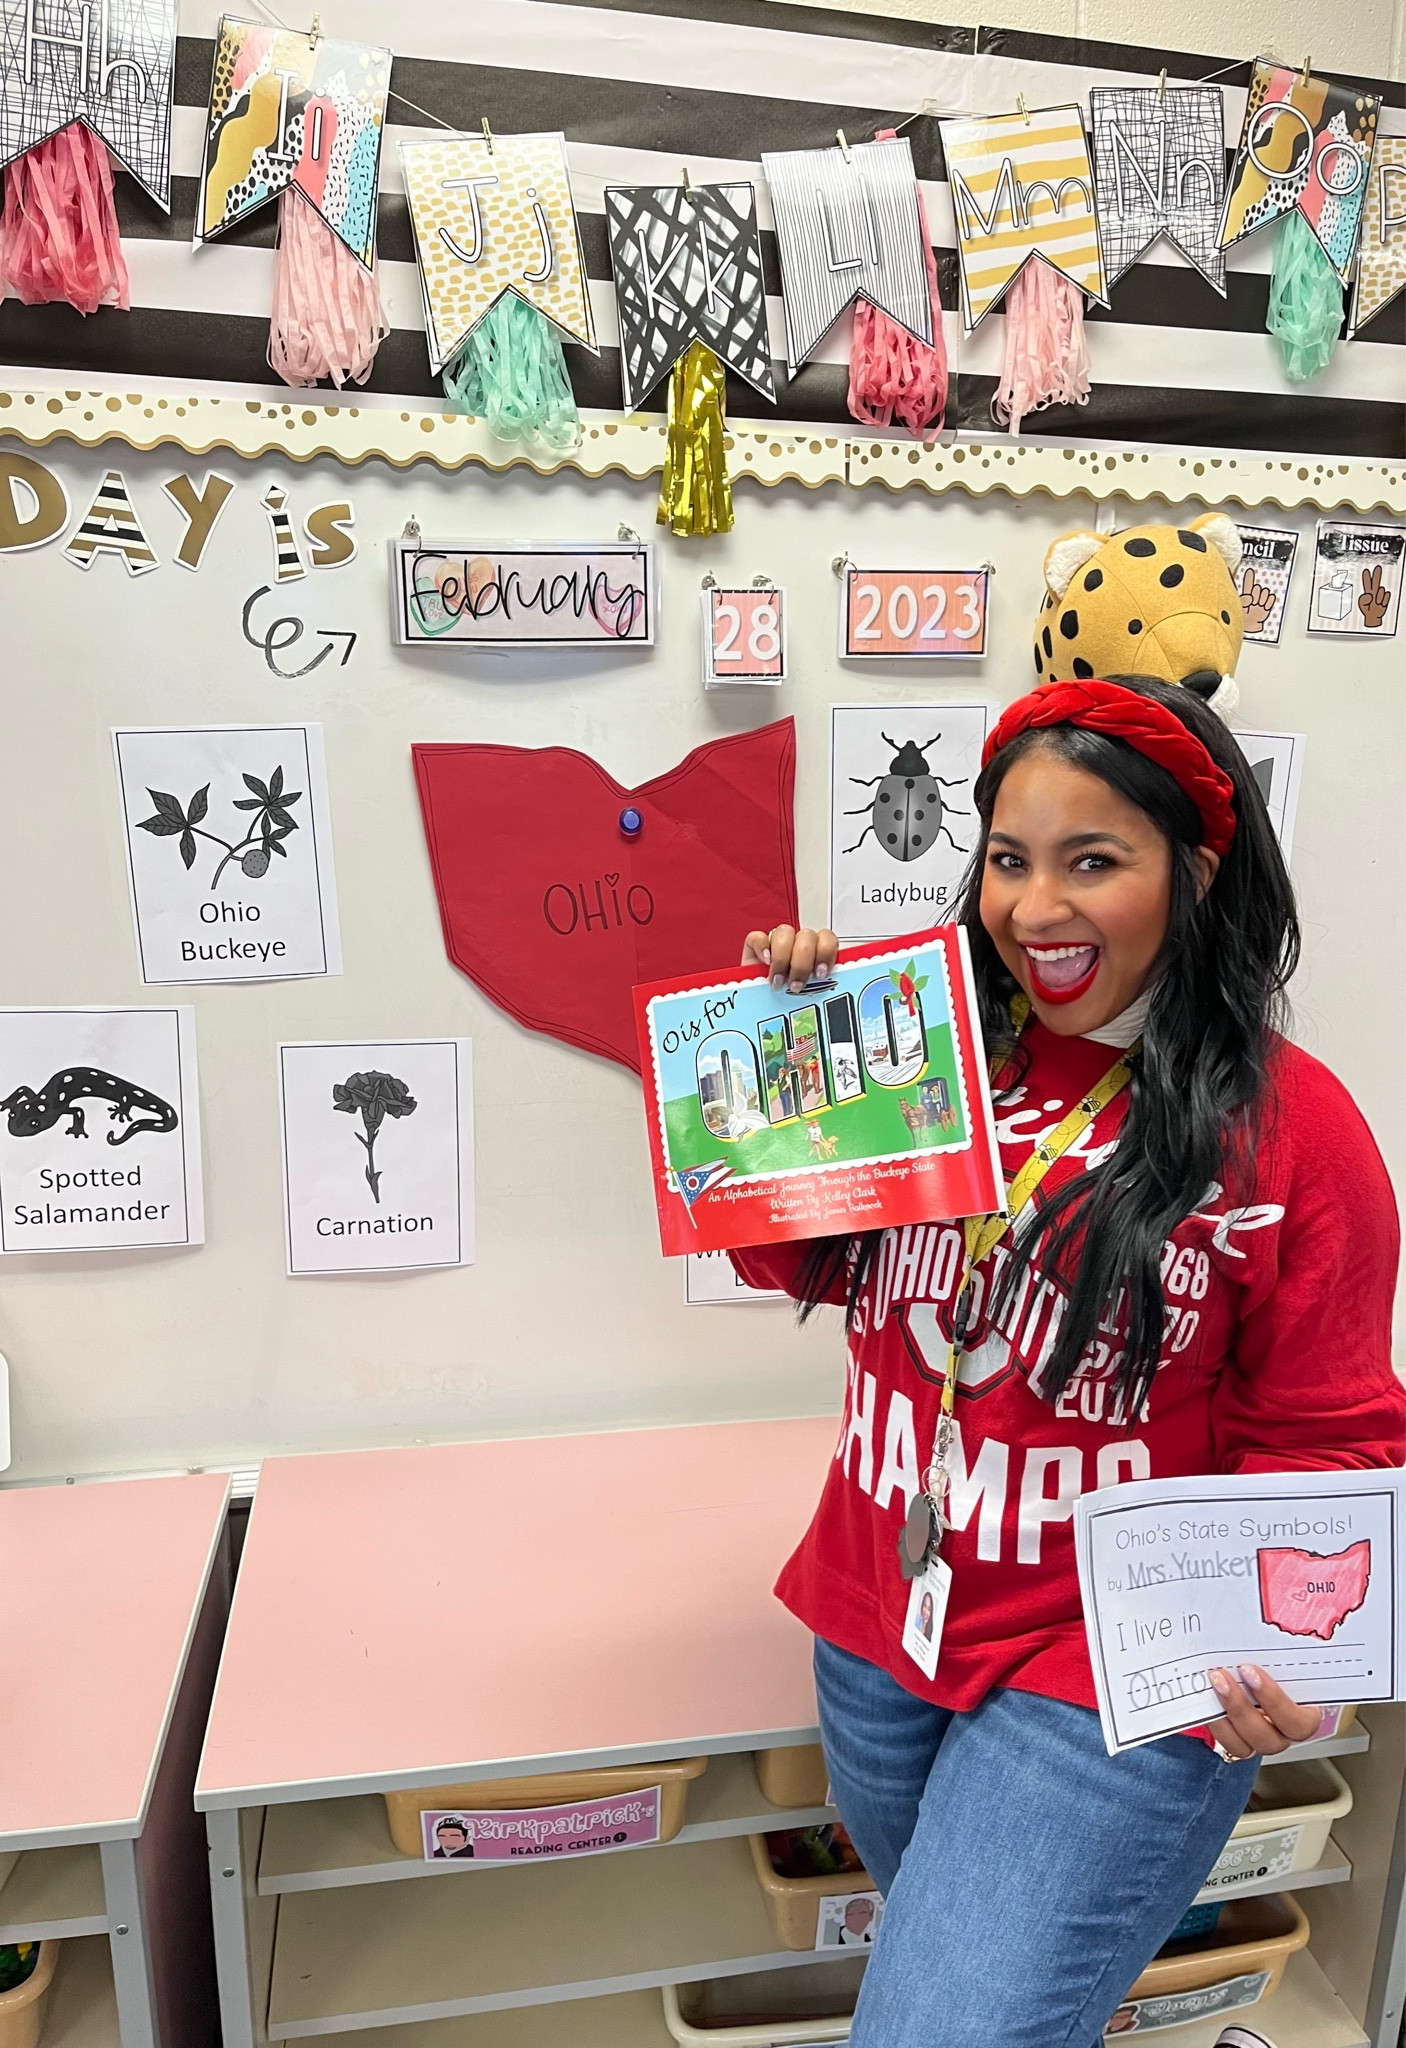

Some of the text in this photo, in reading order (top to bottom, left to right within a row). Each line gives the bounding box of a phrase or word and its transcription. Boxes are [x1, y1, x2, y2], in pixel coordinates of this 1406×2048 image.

[24, 0, 148, 104] Hh
[266, 67, 329, 164] Ii
[1108, 119, 1217, 221] Nn
[1247, 101, 1363, 196] Oo
[952, 157, 1093, 241] Mm
[438, 175, 555, 284] Jj
[815, 172, 879, 272] Ll
[262, 483, 358, 582] is
[1243, 540, 1276, 558] ncil
[1340, 533, 1390, 553] Tissue
[410, 553, 645, 637] February
[422, 595, 445, 611] TRU
[853, 584, 981, 641] 2023
[714, 603, 780, 661] 28
[199, 900, 261, 924] Ohio
[860, 881, 948, 908] Ladybug
[181, 936, 287, 963] Buckeye
[662, 989, 738, 1054] O is for
[695, 974, 929, 1143] OHIO
[39, 1164, 143, 1193] Spotted
[708, 1161, 936, 1205] An Alphabetical Journey Through the Buckeye State
[770, 1196, 803, 1210] Written
[852, 1185, 878, 1199] Clark
[14, 1200, 171, 1227] Salamander
[315, 1212, 435, 1237] Carnation
[873, 1225, 961, 1332] OHIO
[1115, 1514, 1353, 1550] Ohio's State Symbols!
[1108, 1550, 1257, 1592] by Mrs. Yunker
[1306, 1581, 1336, 1594] OHIO
[1117, 1612, 1202, 1651] I live in
[1129, 1667, 1209, 1710] Ohio
[463, 1800, 656, 1845] Kirkpatrick's
[510, 1843, 563, 1856] READING
[567, 1836, 612, 1851] CENTER
[1221, 1870, 1255, 1884] CENTER
